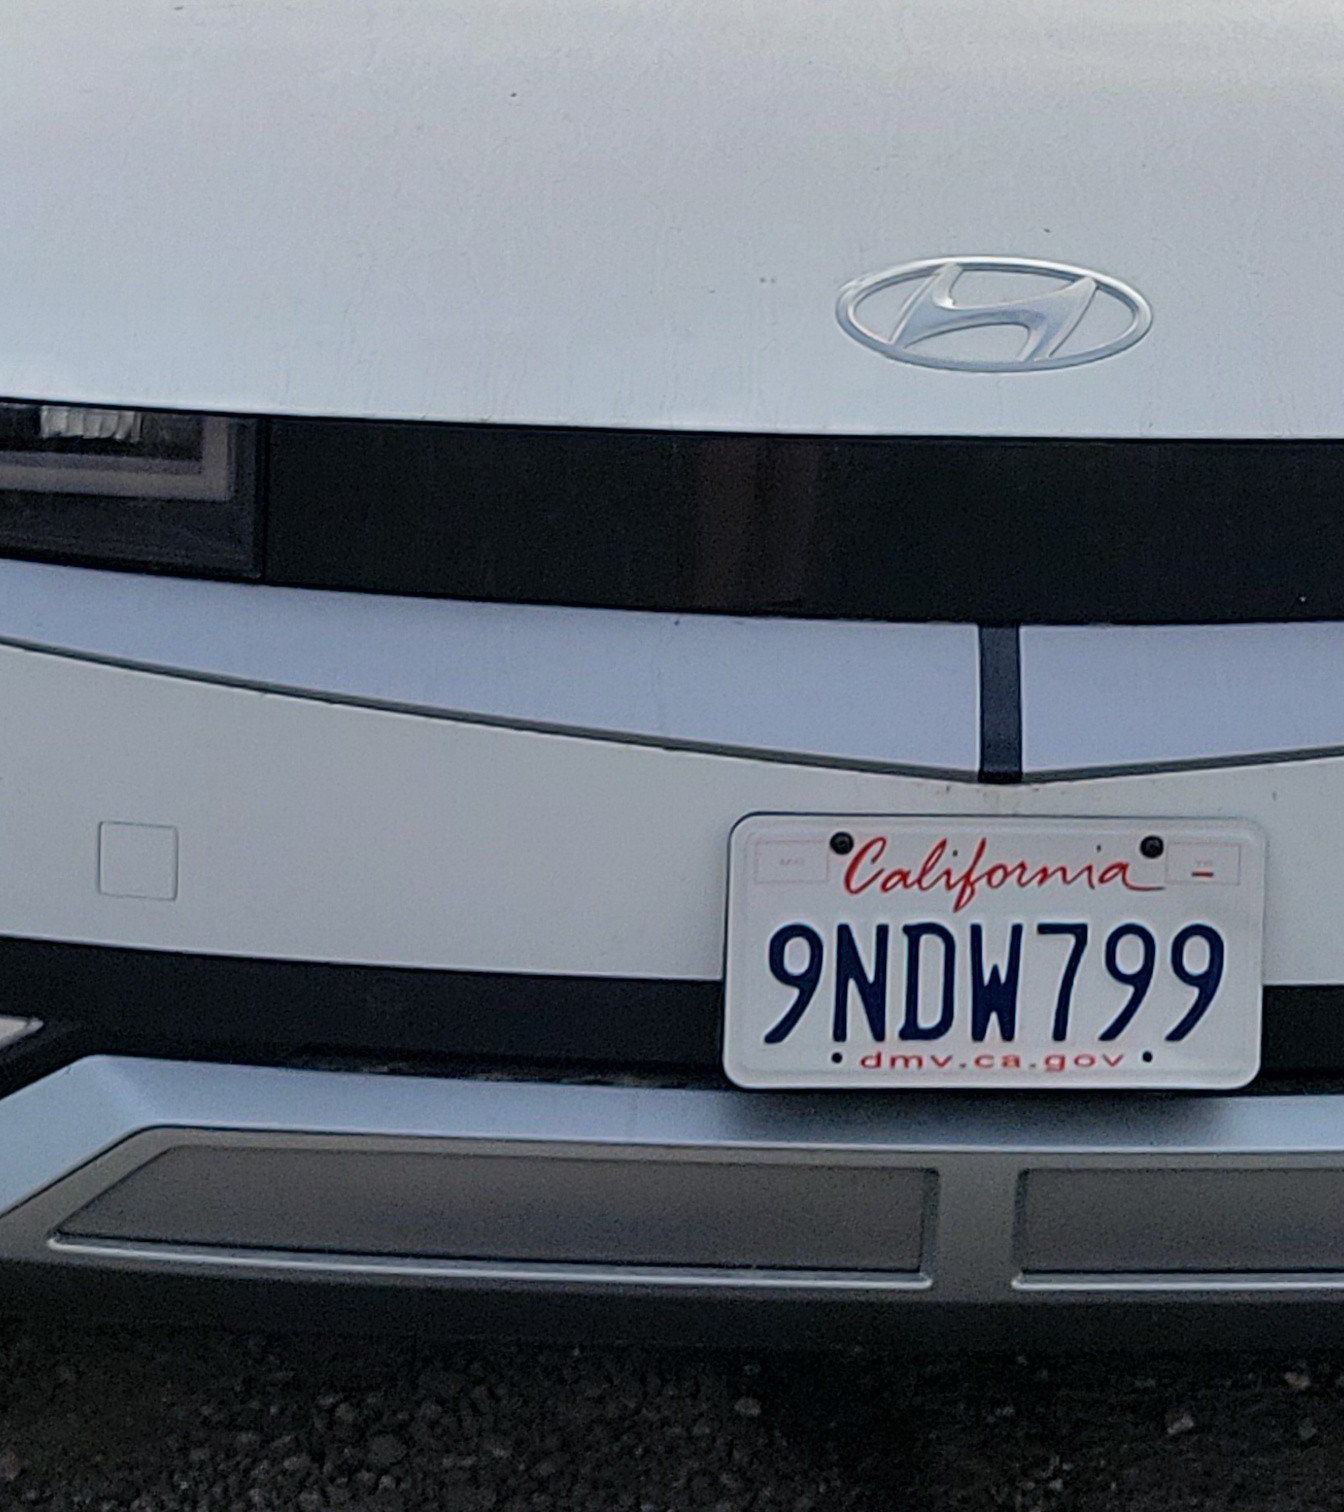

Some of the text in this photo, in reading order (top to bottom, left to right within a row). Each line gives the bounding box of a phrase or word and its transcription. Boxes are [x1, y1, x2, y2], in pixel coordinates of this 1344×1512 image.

[843, 836, 1165, 912] California
[763, 922, 1225, 1044] 9NDW799
[859, 1050, 1126, 1072] dmv.ca.gov
